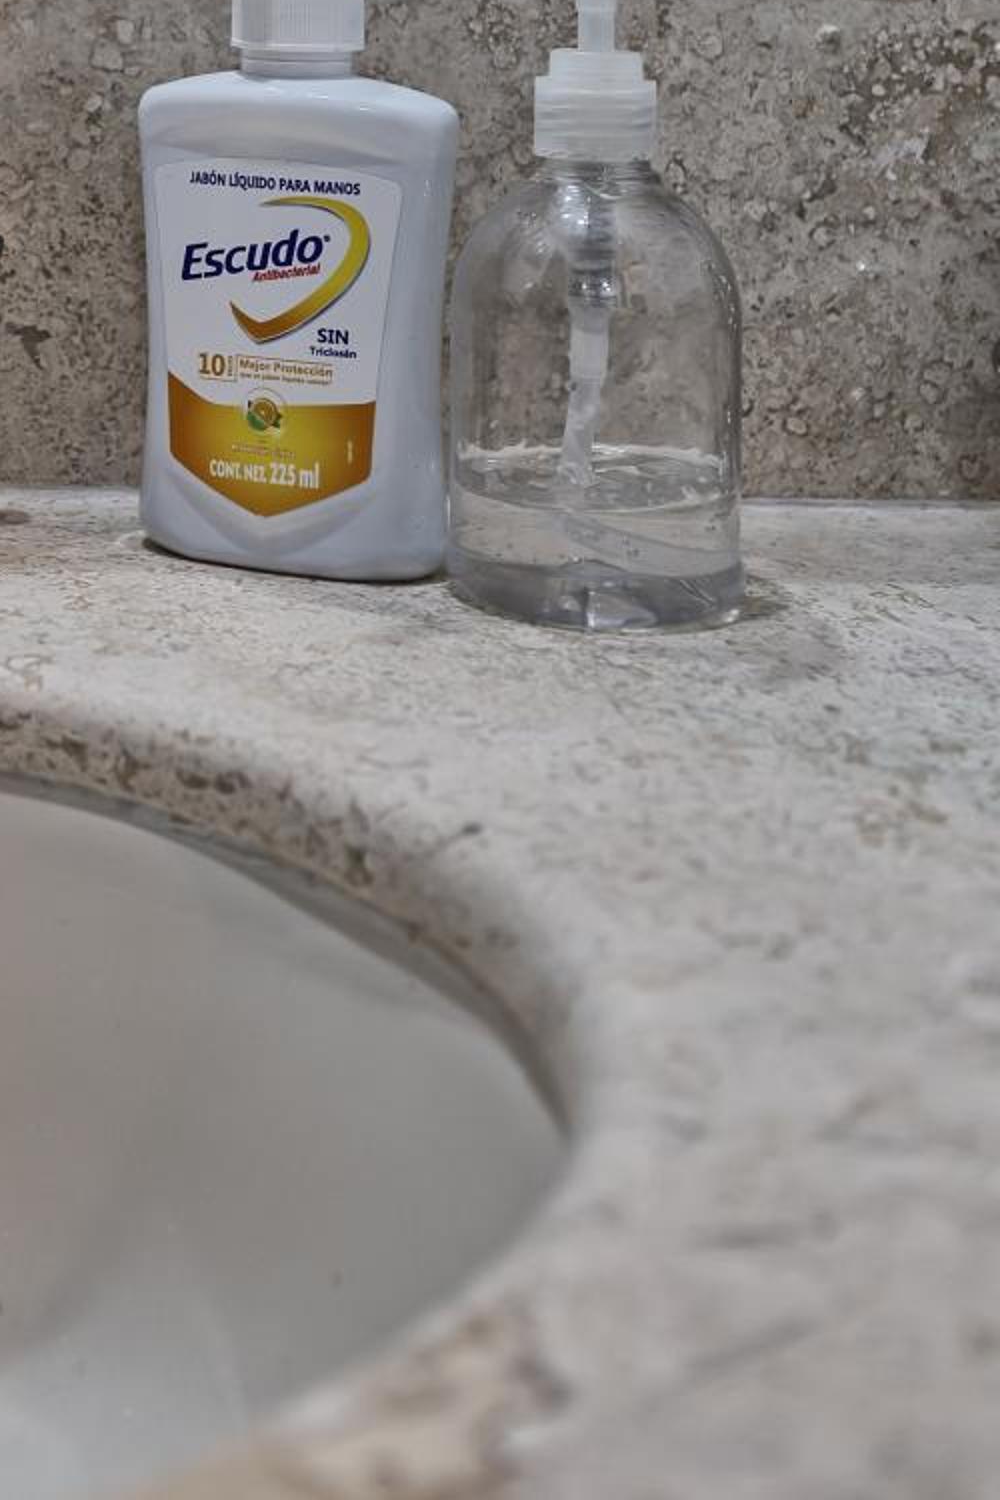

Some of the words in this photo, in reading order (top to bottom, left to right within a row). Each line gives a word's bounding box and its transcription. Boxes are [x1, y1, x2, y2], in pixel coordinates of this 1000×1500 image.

[190, 170, 225, 186] JABÓN
[229, 172, 275, 191] LÍQUIDO
[279, 178, 311, 192] PARA
[314, 180, 361, 195] MANOS
[181, 229, 324, 280] Escudo
[252, 263, 321, 281] Antibacterial
[317, 328, 349, 345] SIN
[198, 353, 225, 376] 10
[270, 462, 296, 486] 225
[299, 461, 319, 490] ml
